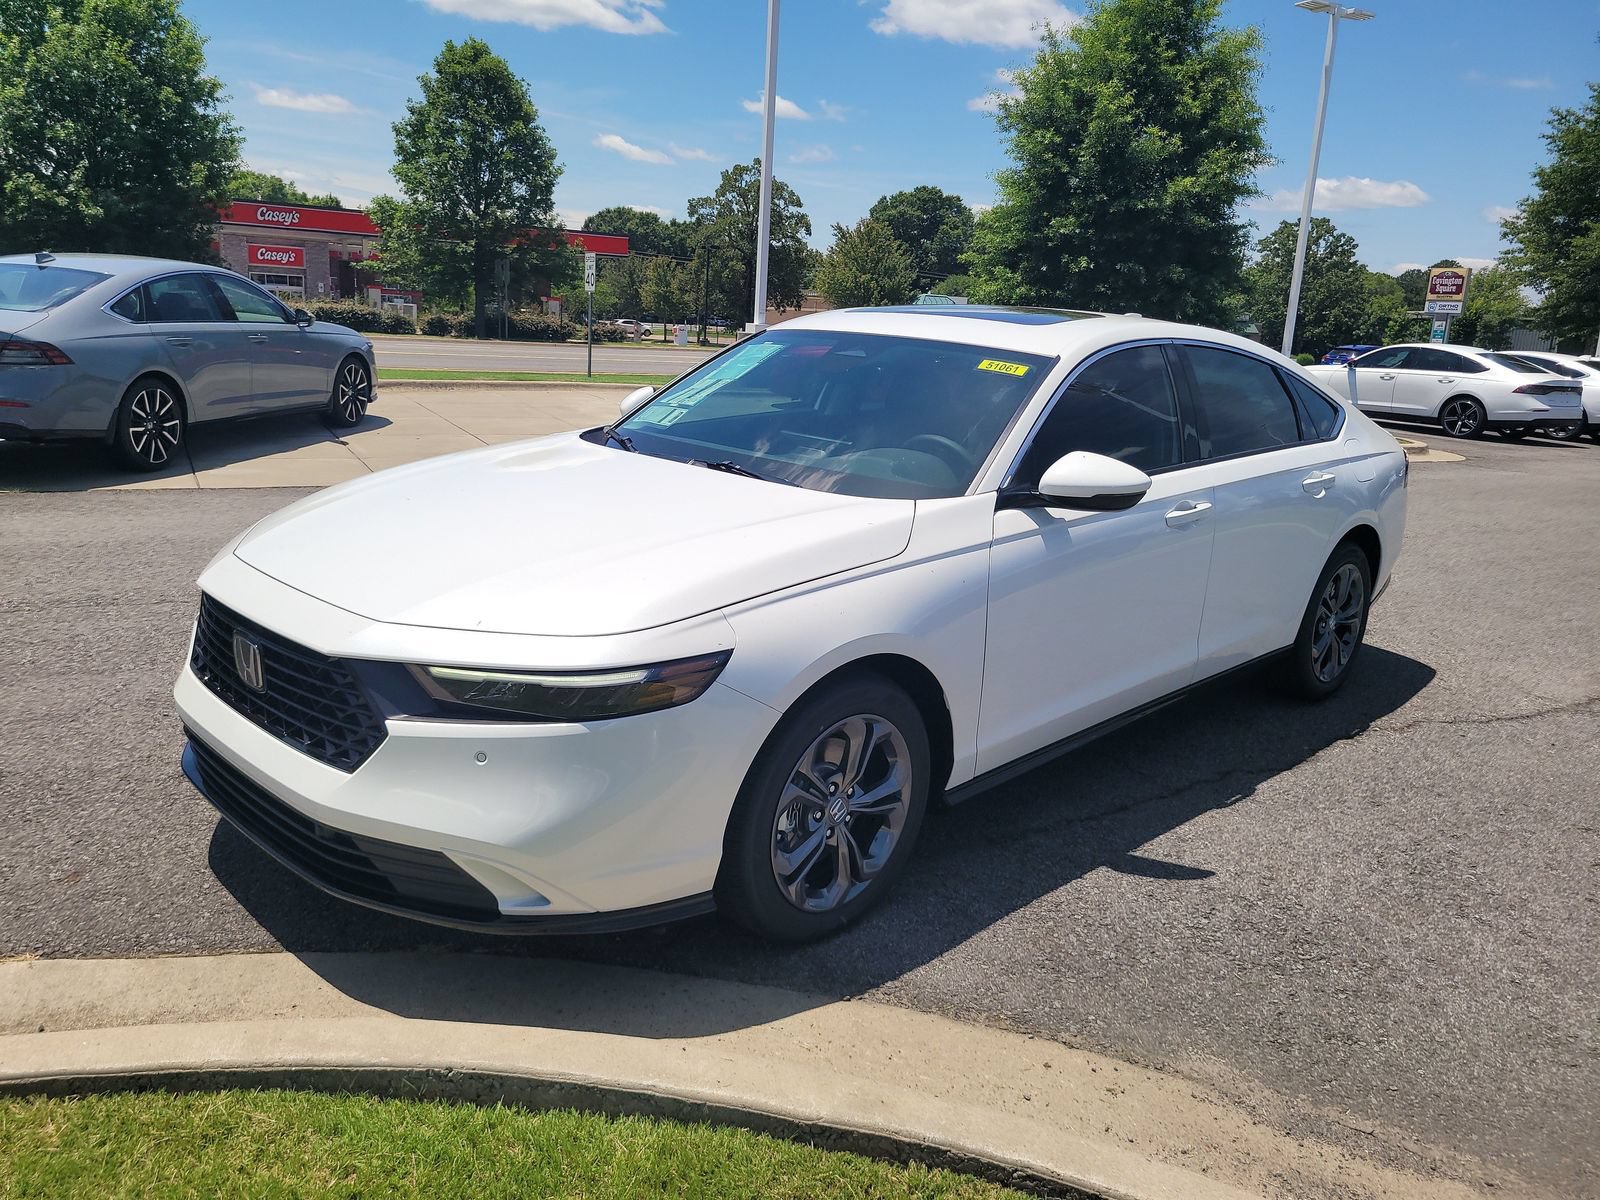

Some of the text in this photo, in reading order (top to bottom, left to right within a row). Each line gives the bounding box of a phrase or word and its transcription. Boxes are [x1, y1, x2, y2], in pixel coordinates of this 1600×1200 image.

[257, 207, 300, 225] Casey's
[257, 248, 296, 263] Casey's
[586, 272, 595, 287] 40
[1432, 277, 1463, 286] Covington
[1435, 284, 1457, 293] Square
[985, 361, 1020, 373] 51061
